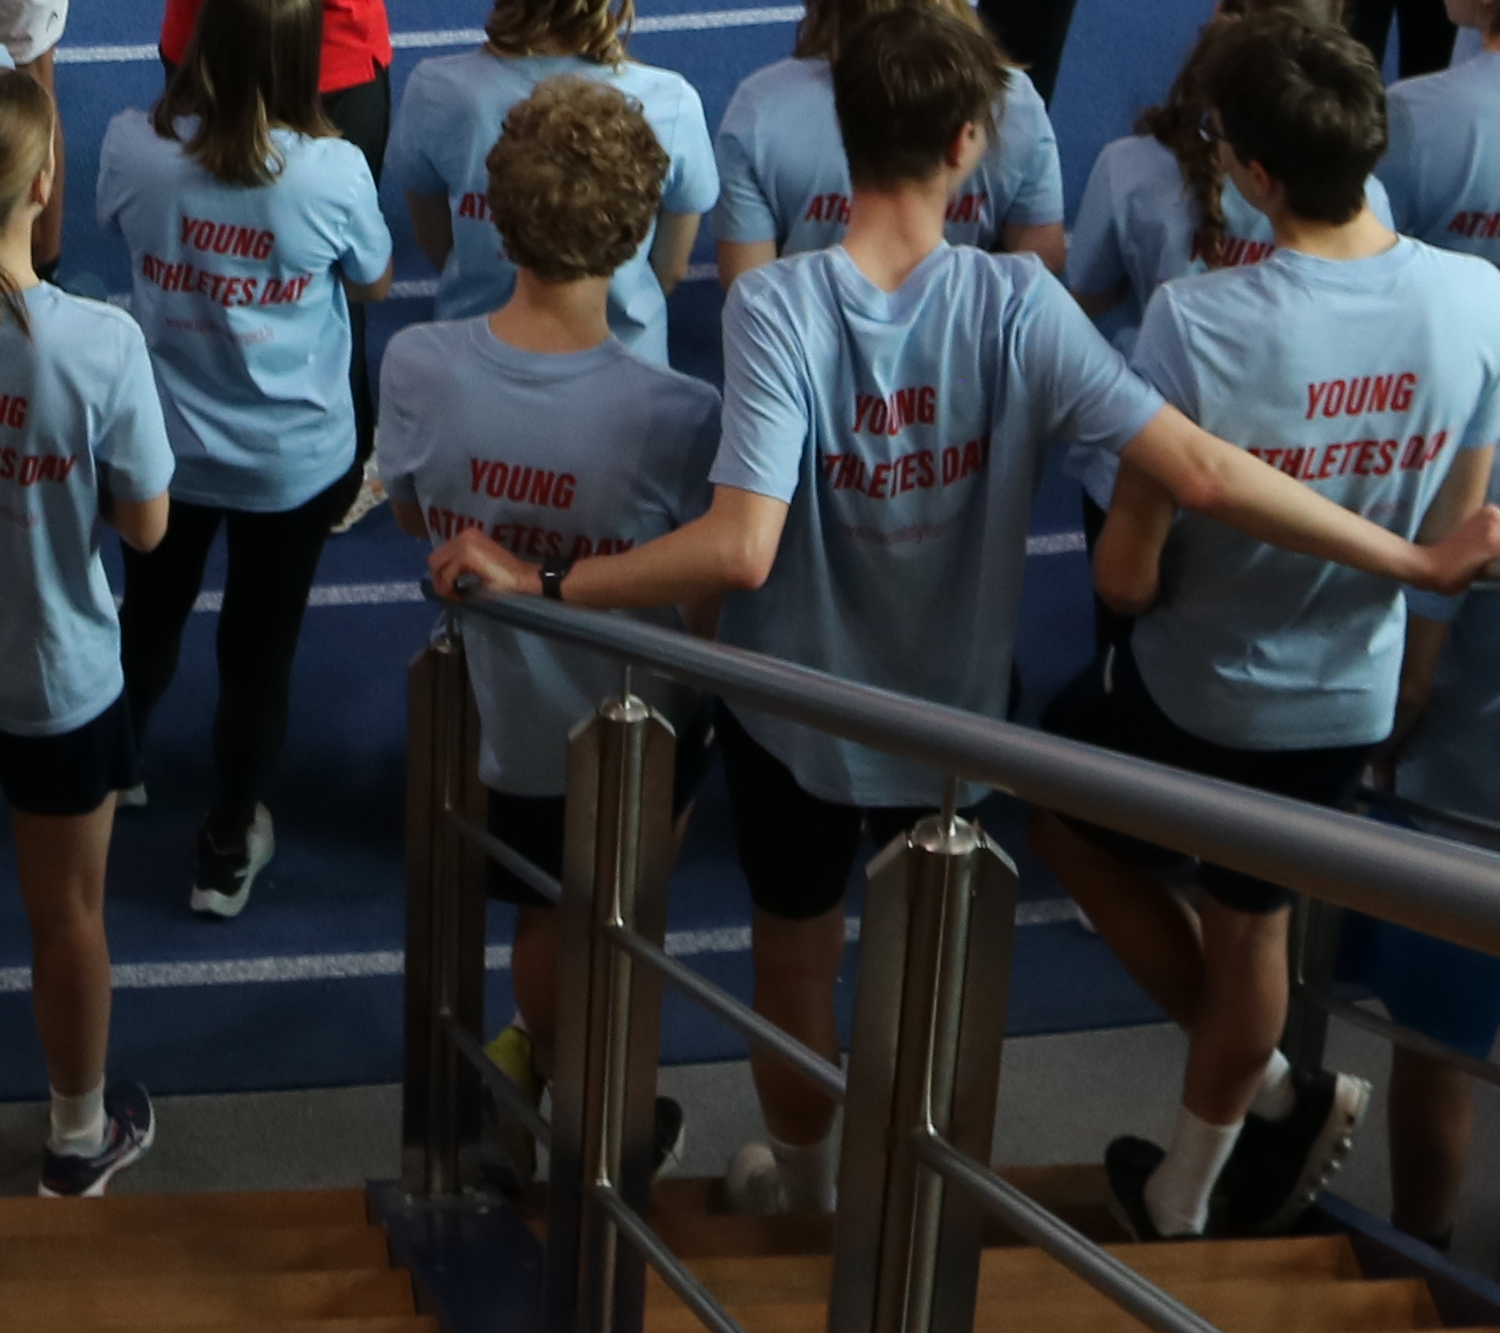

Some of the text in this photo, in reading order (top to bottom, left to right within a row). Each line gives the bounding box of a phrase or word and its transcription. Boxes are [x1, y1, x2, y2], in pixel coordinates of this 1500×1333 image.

[181, 216, 275, 260] YOUNG
[141, 253, 313, 307] ATHLETES DAY
[852, 386, 936, 437] YOUNG
[1305, 372, 1418, 420] YOUNG
[18, 454, 78, 487] DAY
[469, 457, 576, 511] YOUNG
[824, 452, 935, 500] THLETES
